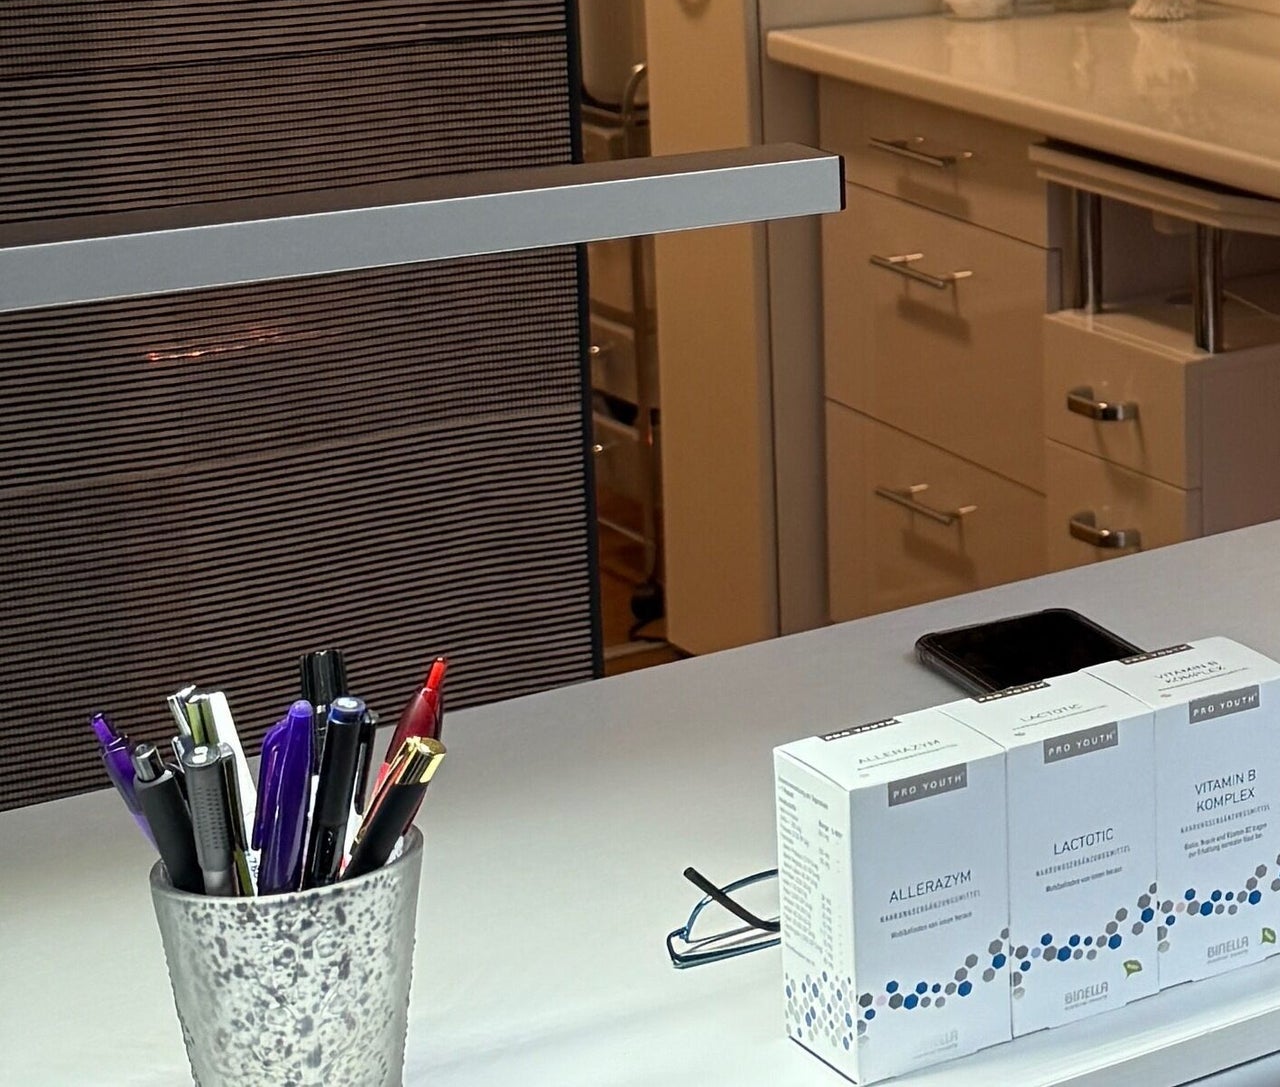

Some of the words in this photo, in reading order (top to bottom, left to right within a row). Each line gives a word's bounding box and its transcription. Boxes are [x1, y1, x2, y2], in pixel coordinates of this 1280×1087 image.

[1193, 705, 1215, 717] PRO
[1048, 743, 1071, 757] PRO
[893, 787, 917, 800] PRO
[1194, 772, 1245, 795] VITAMIN
[1248, 769, 1257, 782] B
[1196, 787, 1256, 813] KOMPLEX
[1053, 827, 1114, 855] LACTOTIC
[889, 869, 972, 904] ALLERAZYM
[1207, 935, 1249, 959] BINELLA
[1064, 981, 1109, 1004] BINELLA
